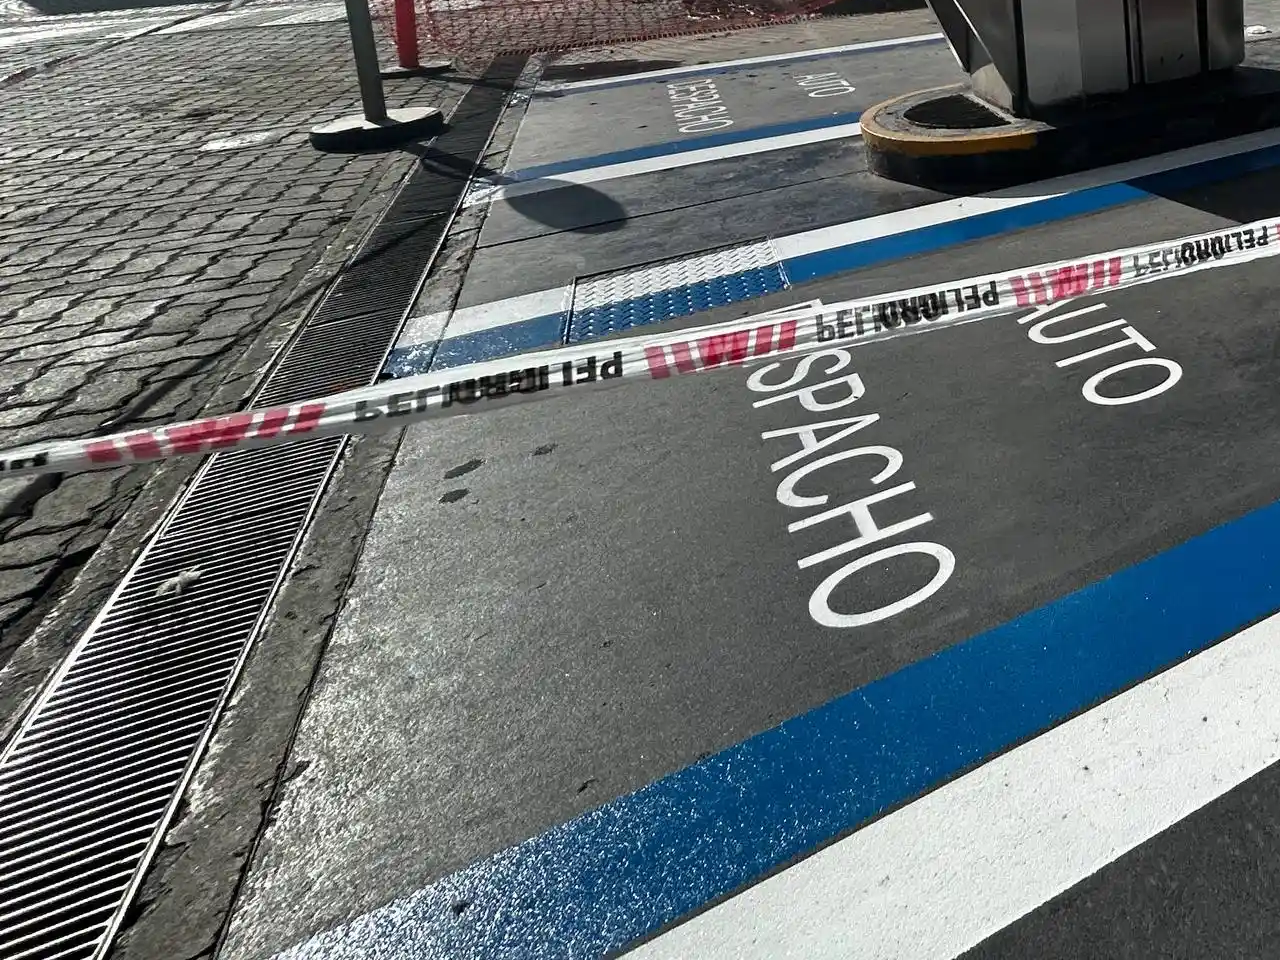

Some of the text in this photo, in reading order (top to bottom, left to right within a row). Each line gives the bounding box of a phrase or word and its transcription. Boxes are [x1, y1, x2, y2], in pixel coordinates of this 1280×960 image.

[666, 78, 734, 133] DESPACHO
[792, 72, 856, 97] AUTO
[746, 298, 956, 628] SPACHO
